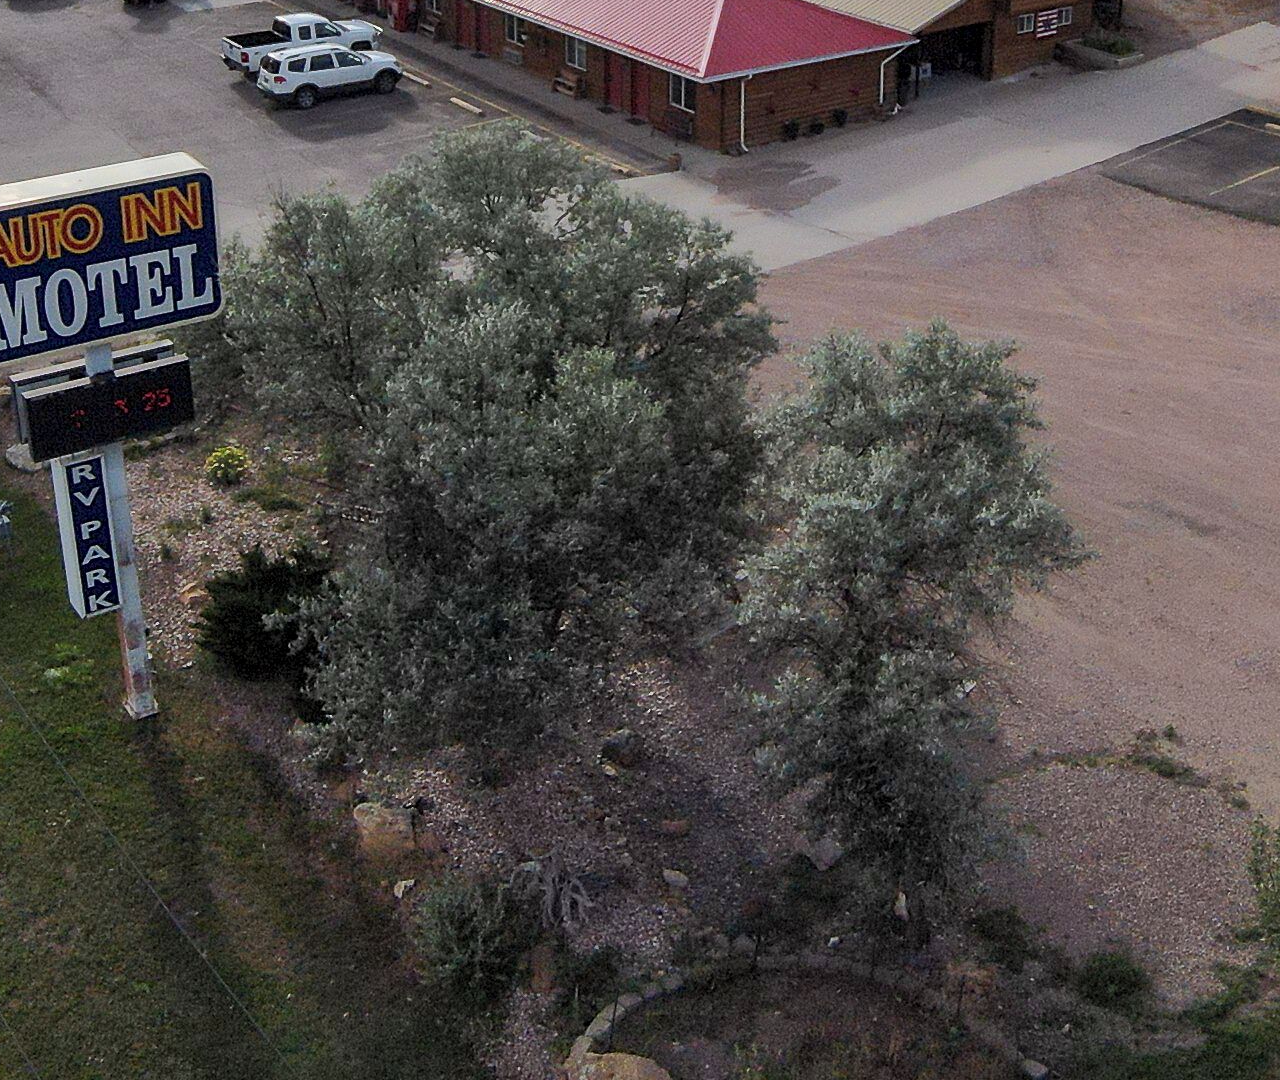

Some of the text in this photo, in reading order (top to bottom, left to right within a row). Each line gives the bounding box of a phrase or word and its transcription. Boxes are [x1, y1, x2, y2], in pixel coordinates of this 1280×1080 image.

[121, 183, 202, 243] INN
[72, 464, 113, 612] RV PARK
